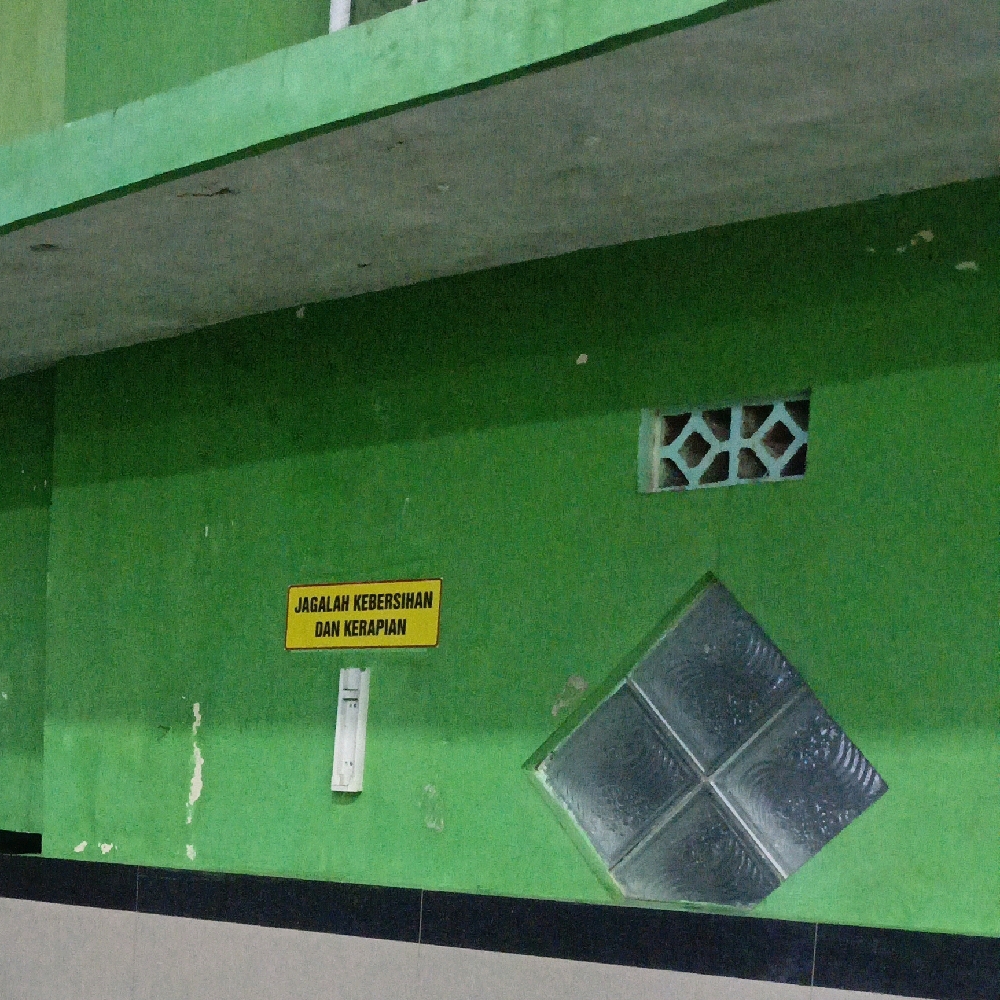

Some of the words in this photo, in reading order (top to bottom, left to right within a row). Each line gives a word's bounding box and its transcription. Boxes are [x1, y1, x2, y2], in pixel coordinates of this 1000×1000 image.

[295, 595, 349, 613] JAGALAH
[354, 591, 433, 611] KEBERSIHAN
[315, 621, 340, 637] DAN
[344, 619, 406, 637] KERAPIAN
